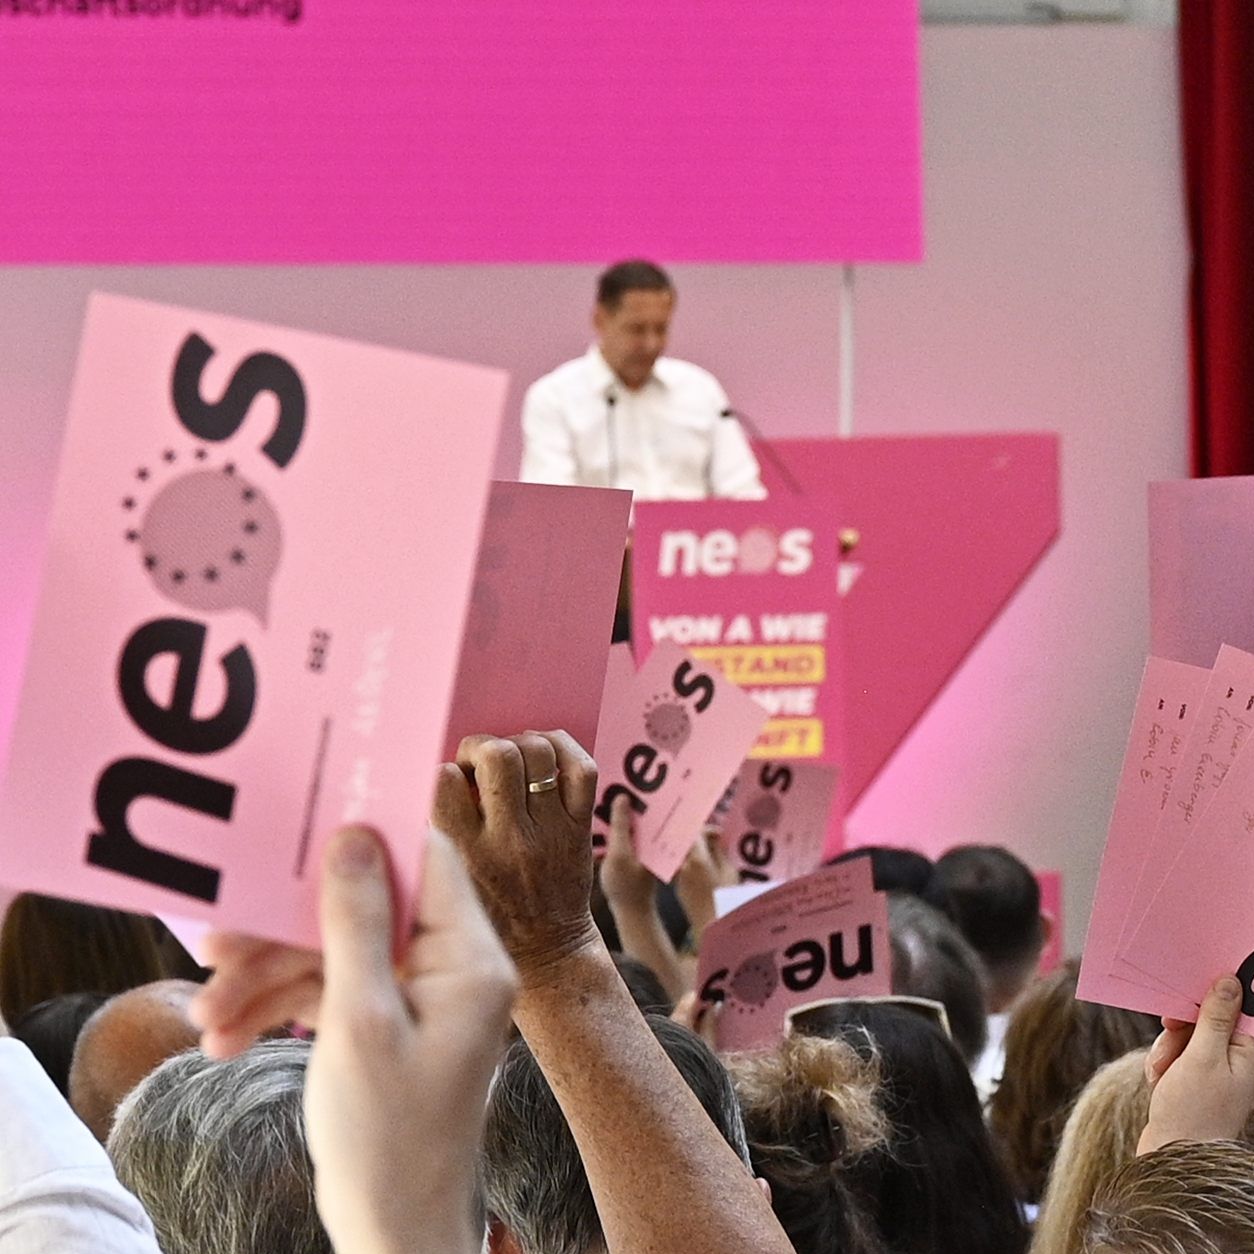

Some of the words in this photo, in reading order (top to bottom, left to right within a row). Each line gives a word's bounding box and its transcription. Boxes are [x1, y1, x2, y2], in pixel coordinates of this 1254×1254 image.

[657, 527, 814, 577] neos
[83, 331, 308, 904] neos
[648, 616, 722, 644] VON
[725, 616, 753, 643] A
[759, 612, 828, 643] WIE
